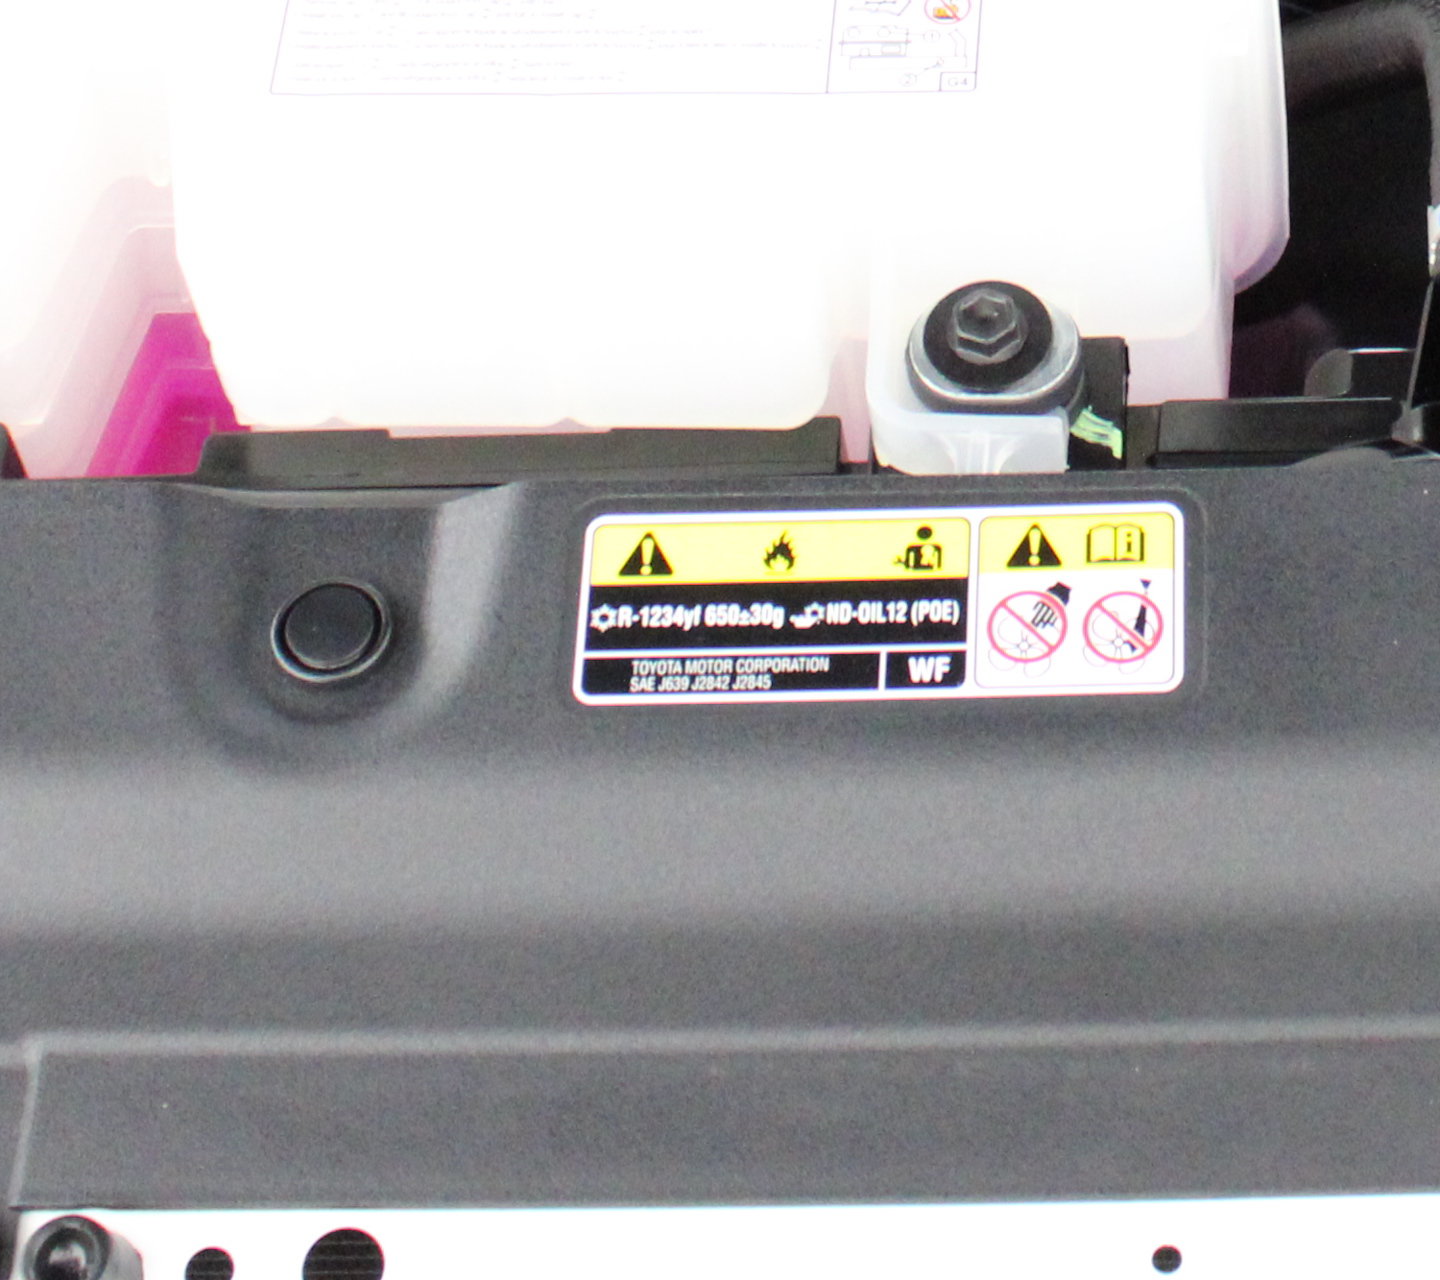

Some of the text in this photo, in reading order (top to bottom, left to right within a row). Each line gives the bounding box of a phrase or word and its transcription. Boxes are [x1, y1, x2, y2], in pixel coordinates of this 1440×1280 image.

[616, 600, 961, 632] R-1234yf 650±30g ND-OIL12 (POE)
[631, 656, 831, 676] TOYOTA MOTOR CORPORATION
[907, 656, 953, 684] WF
[628, 674, 773, 693] SAE J639 J2842 J2845
